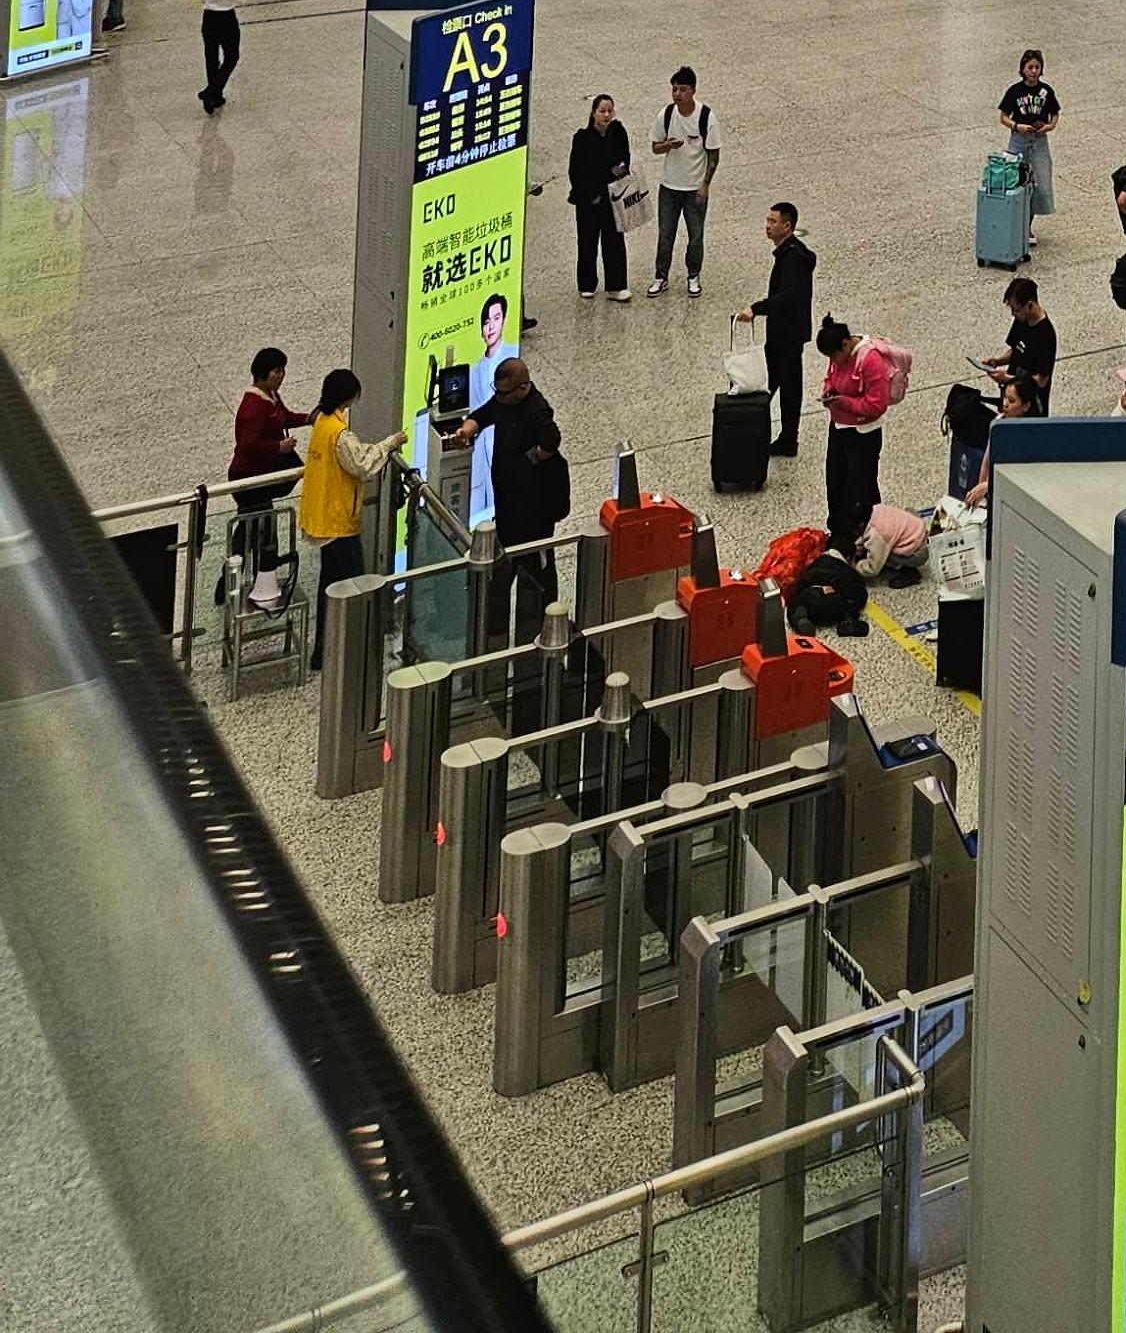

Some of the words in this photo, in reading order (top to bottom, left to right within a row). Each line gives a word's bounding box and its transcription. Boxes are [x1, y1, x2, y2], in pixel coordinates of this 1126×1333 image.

[442, 15, 472, 35] 检票口
[474, 6, 502, 25] Check
[503, 4, 513, 17] in
[442, 23, 508, 93] A3
[425, 132, 518, 177] 开车前4分钟停止检票
[423, 194, 456, 224] EKO
[422, 212, 512, 262] 高端智能垃圾桶
[422, 235, 511, 294] 就选EKO
